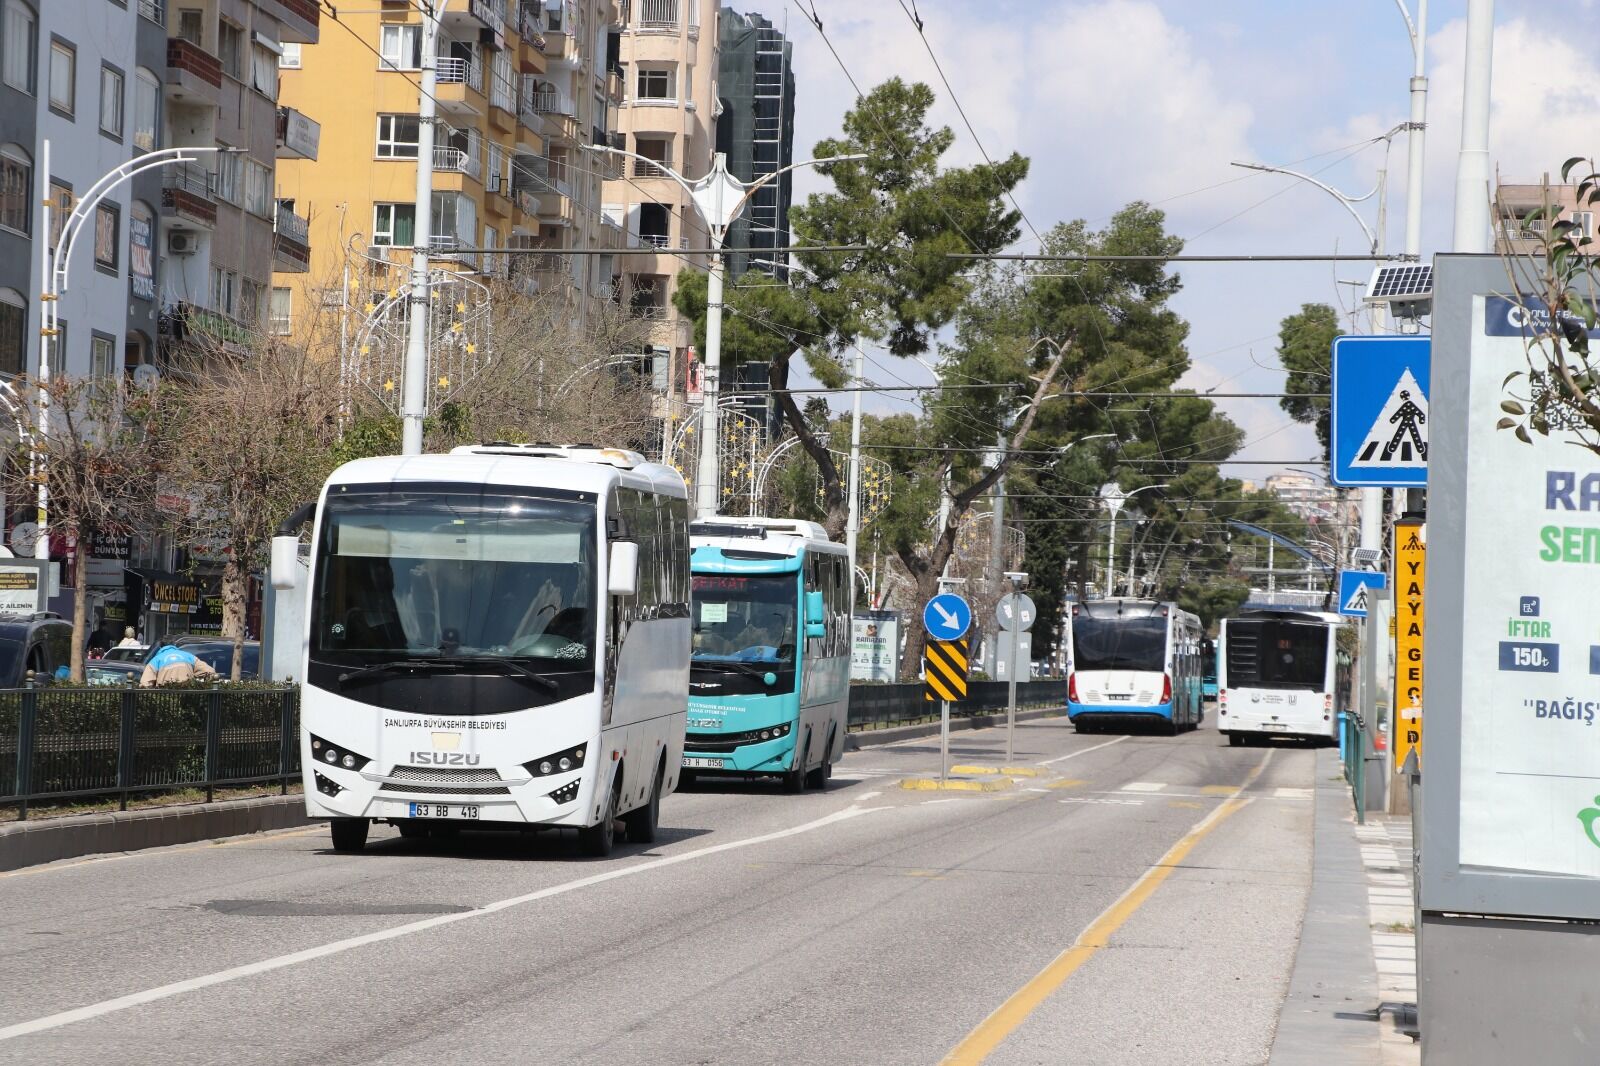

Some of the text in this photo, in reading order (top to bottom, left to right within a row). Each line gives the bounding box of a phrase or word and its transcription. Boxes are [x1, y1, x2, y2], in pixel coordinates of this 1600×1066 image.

[177, 585, 197, 602] STORE
[1508, 617, 1552, 638] İFTAR
[856, 636, 887, 644] RAMAZAN
[384, 717, 507, 730] ŞANLIURFA BÜYÜKŞEHİR BELEDİYESİ
[410, 751, 481, 766] ISUZU
[416, 804, 478, 818] 63 BB 413
